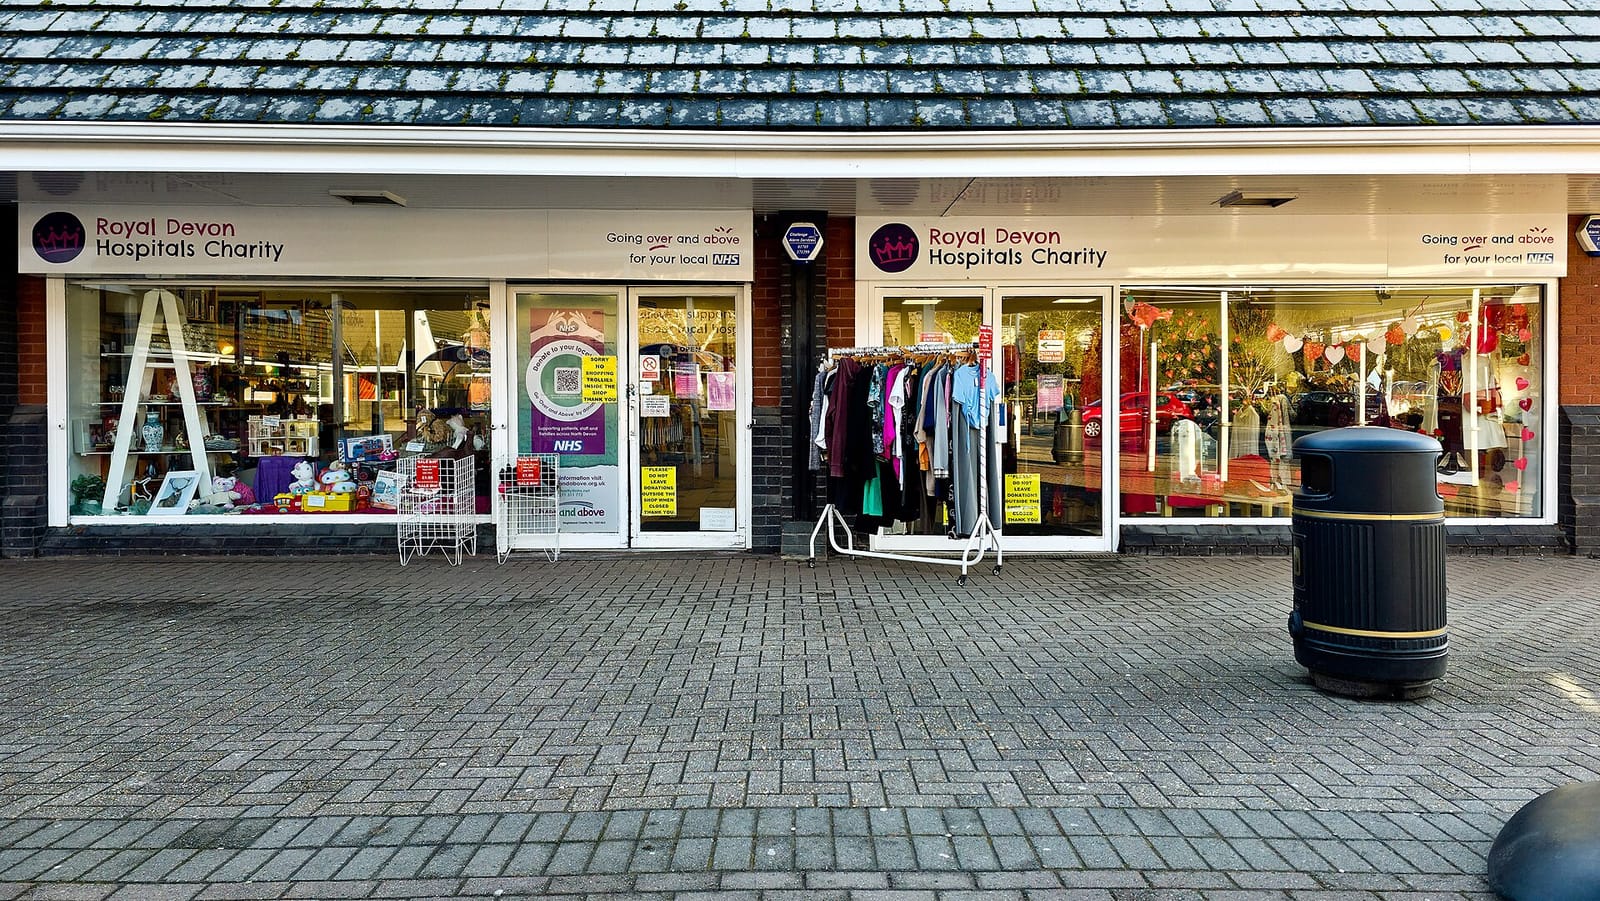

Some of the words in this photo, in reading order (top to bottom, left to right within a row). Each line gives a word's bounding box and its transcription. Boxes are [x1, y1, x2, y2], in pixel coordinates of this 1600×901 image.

[96, 218, 155, 239] Royal
[167, 219, 235, 236] Devon
[607, 233, 643, 244] Going
[647, 235, 673, 244] over
[677, 234, 700, 244] and
[704, 234, 740, 244] above
[930, 228, 986, 248] Royal
[996, 229, 1061, 245] Devon
[1422, 234, 1458, 245] Going
[1462, 236, 1487, 245] over
[1492, 235, 1514, 244] and
[1518, 235, 1554, 244] above
[96, 239, 195, 262] Hospitals
[205, 240, 284, 262] Charity
[629, 253, 646, 263] for
[650, 255, 676, 265] your
[680, 254, 708, 264] local
[713, 254, 739, 265] NHS
[930, 248, 1023, 269] Hospitals
[1032, 248, 1108, 268] Charity
[1444, 254, 1460, 264] for
[1465, 255, 1490, 265] your
[1494, 254, 1522, 264] local
[1527, 253, 1553, 264] NHS
[533, 351, 551, 371] Donate
[554, 440, 583, 451] NHS
[559, 507, 576, 517] and
[577, 507, 605, 517] above
